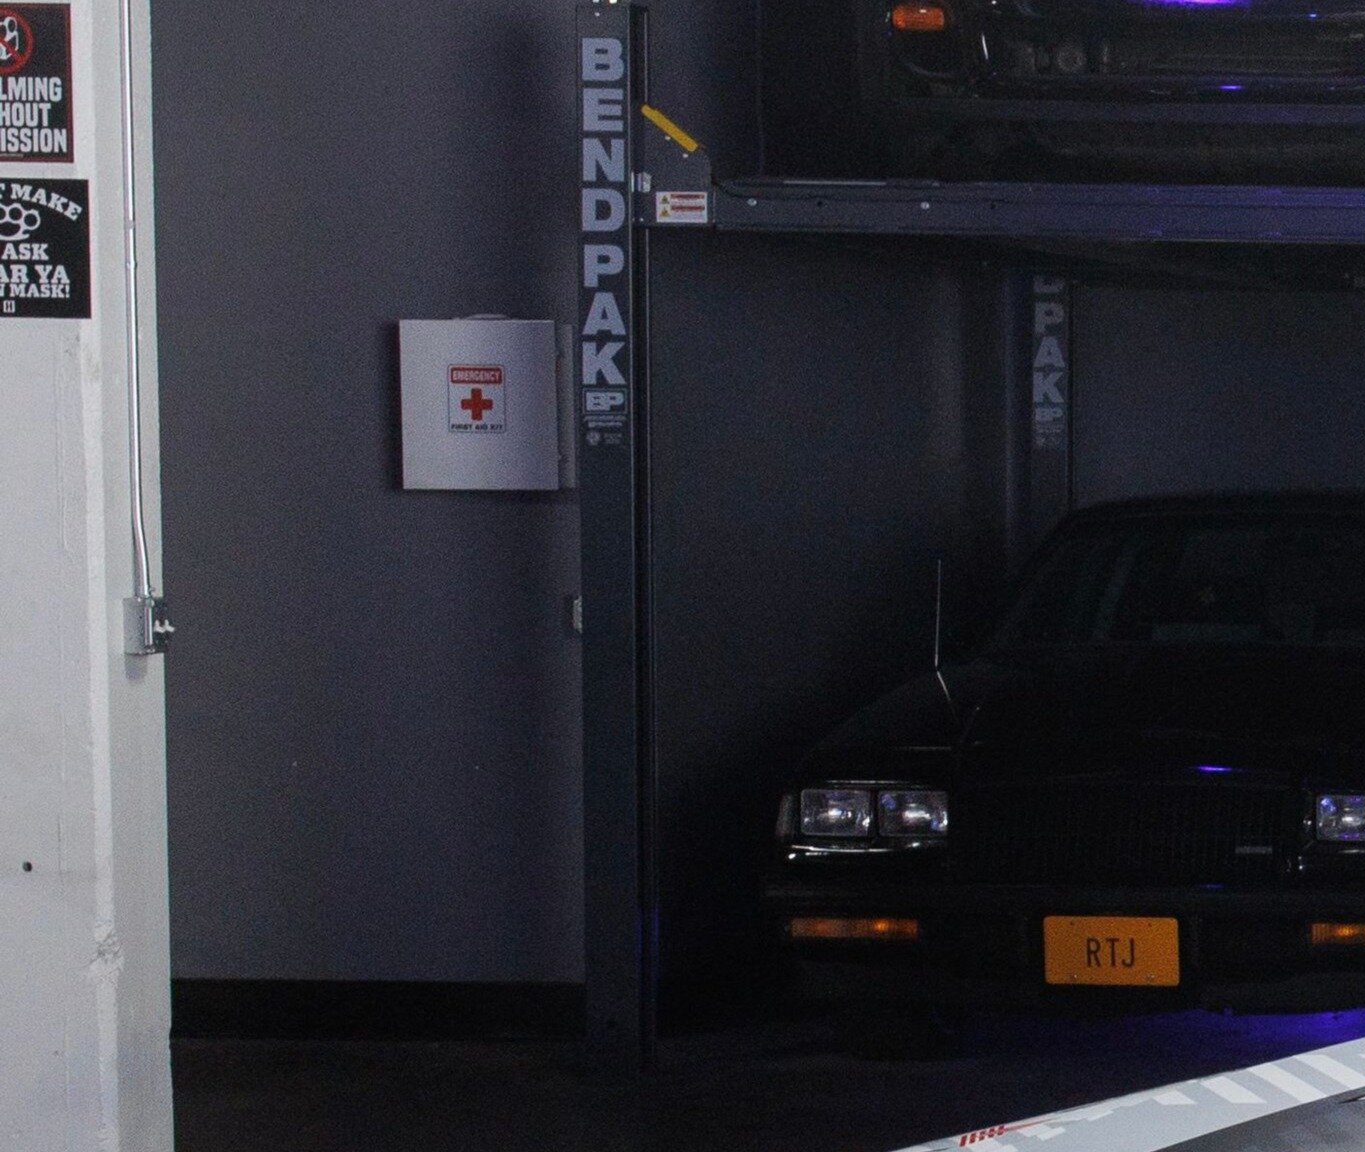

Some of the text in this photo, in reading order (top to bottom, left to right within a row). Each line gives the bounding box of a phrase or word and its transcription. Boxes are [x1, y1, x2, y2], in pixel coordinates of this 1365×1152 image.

[0, 76, 63, 102] LMING
[0, 102, 51, 127] HOUT
[0, 128, 67, 153] ISSION
[10, 183, 82, 220] MAKE
[581, 37, 626, 386] BENDPAK
[2, 242, 49, 260] ASK
[0, 264, 70, 283] AR YA
[10, 284, 70, 298] MASK!
[1086, 938, 1138, 970] RTJ
